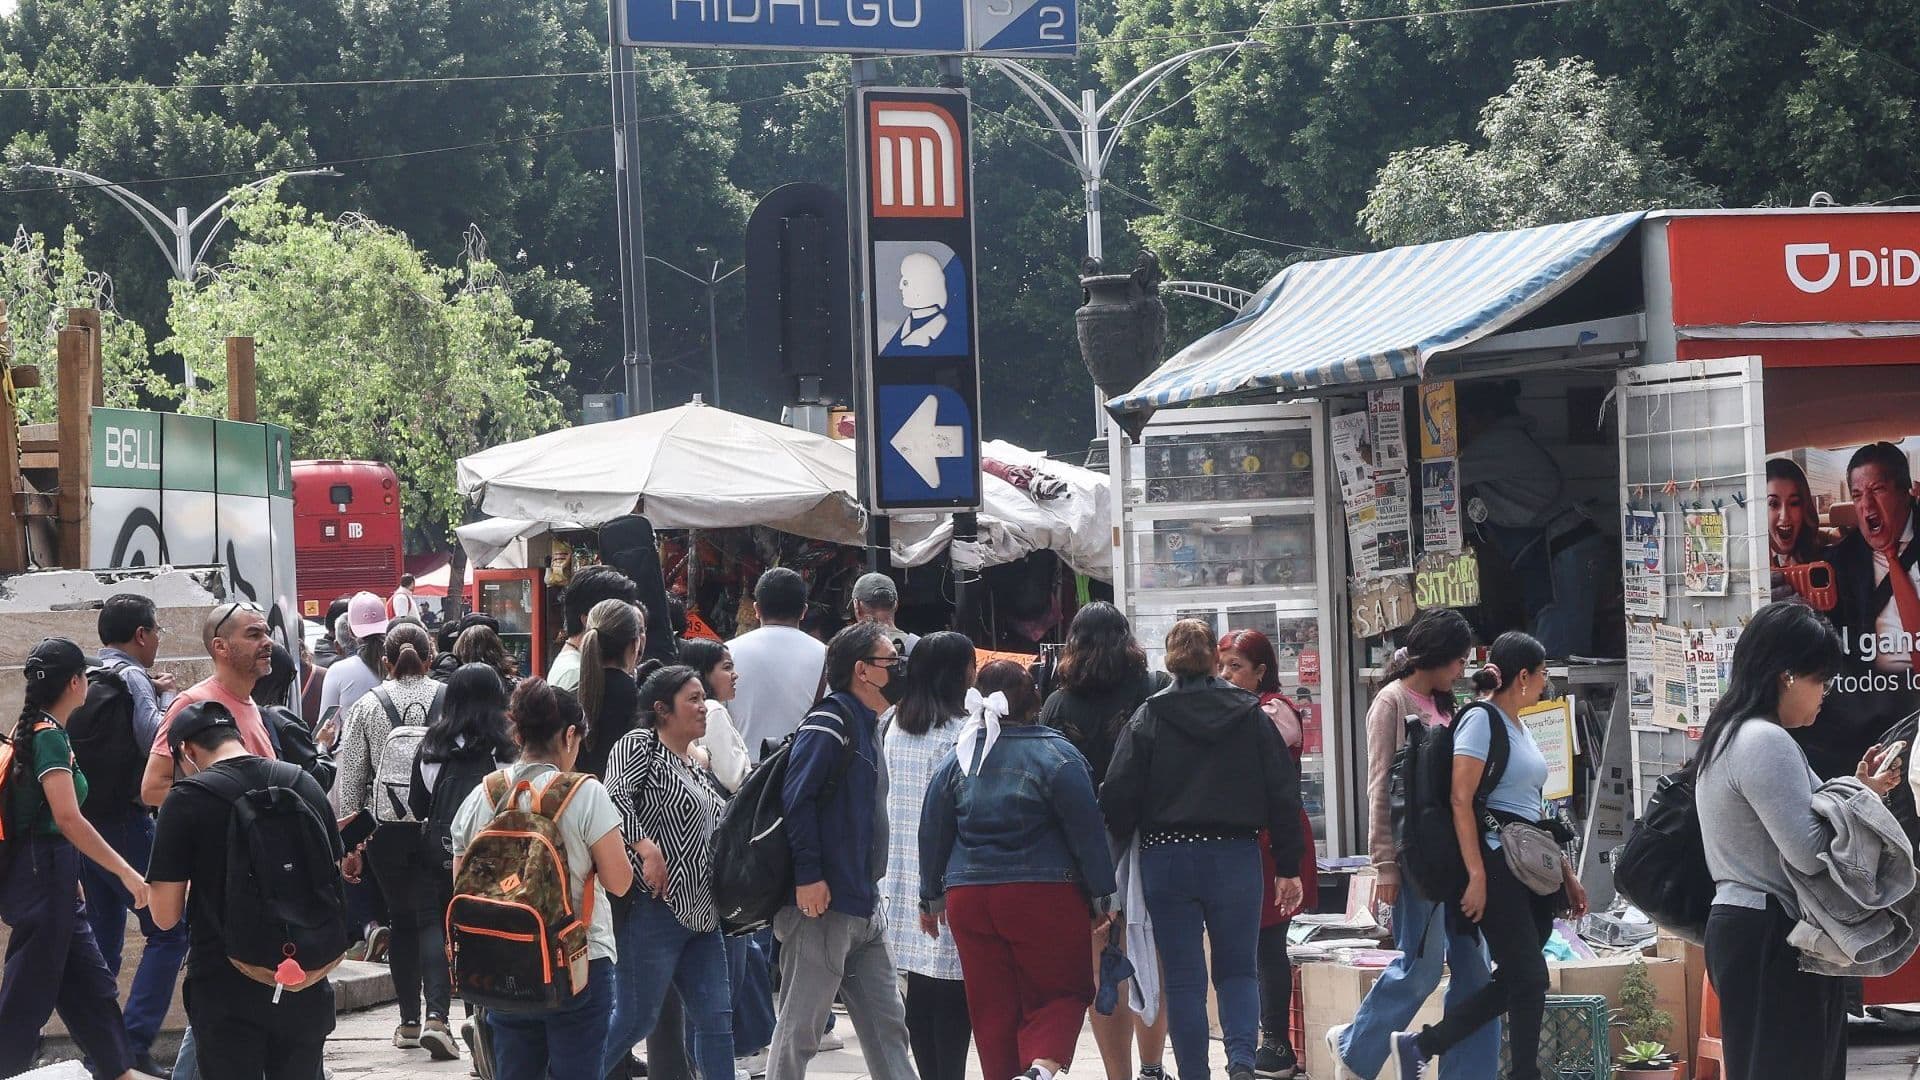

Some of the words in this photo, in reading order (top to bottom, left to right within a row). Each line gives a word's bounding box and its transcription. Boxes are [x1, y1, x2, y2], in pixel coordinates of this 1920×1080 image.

[1039, 6, 1065, 40] 2
[1416, 571, 1448, 609] SAT
[1684, 650, 1696, 662] La
[1697, 649, 1714, 662] Raz
[1834, 669, 1899, 693] todos
